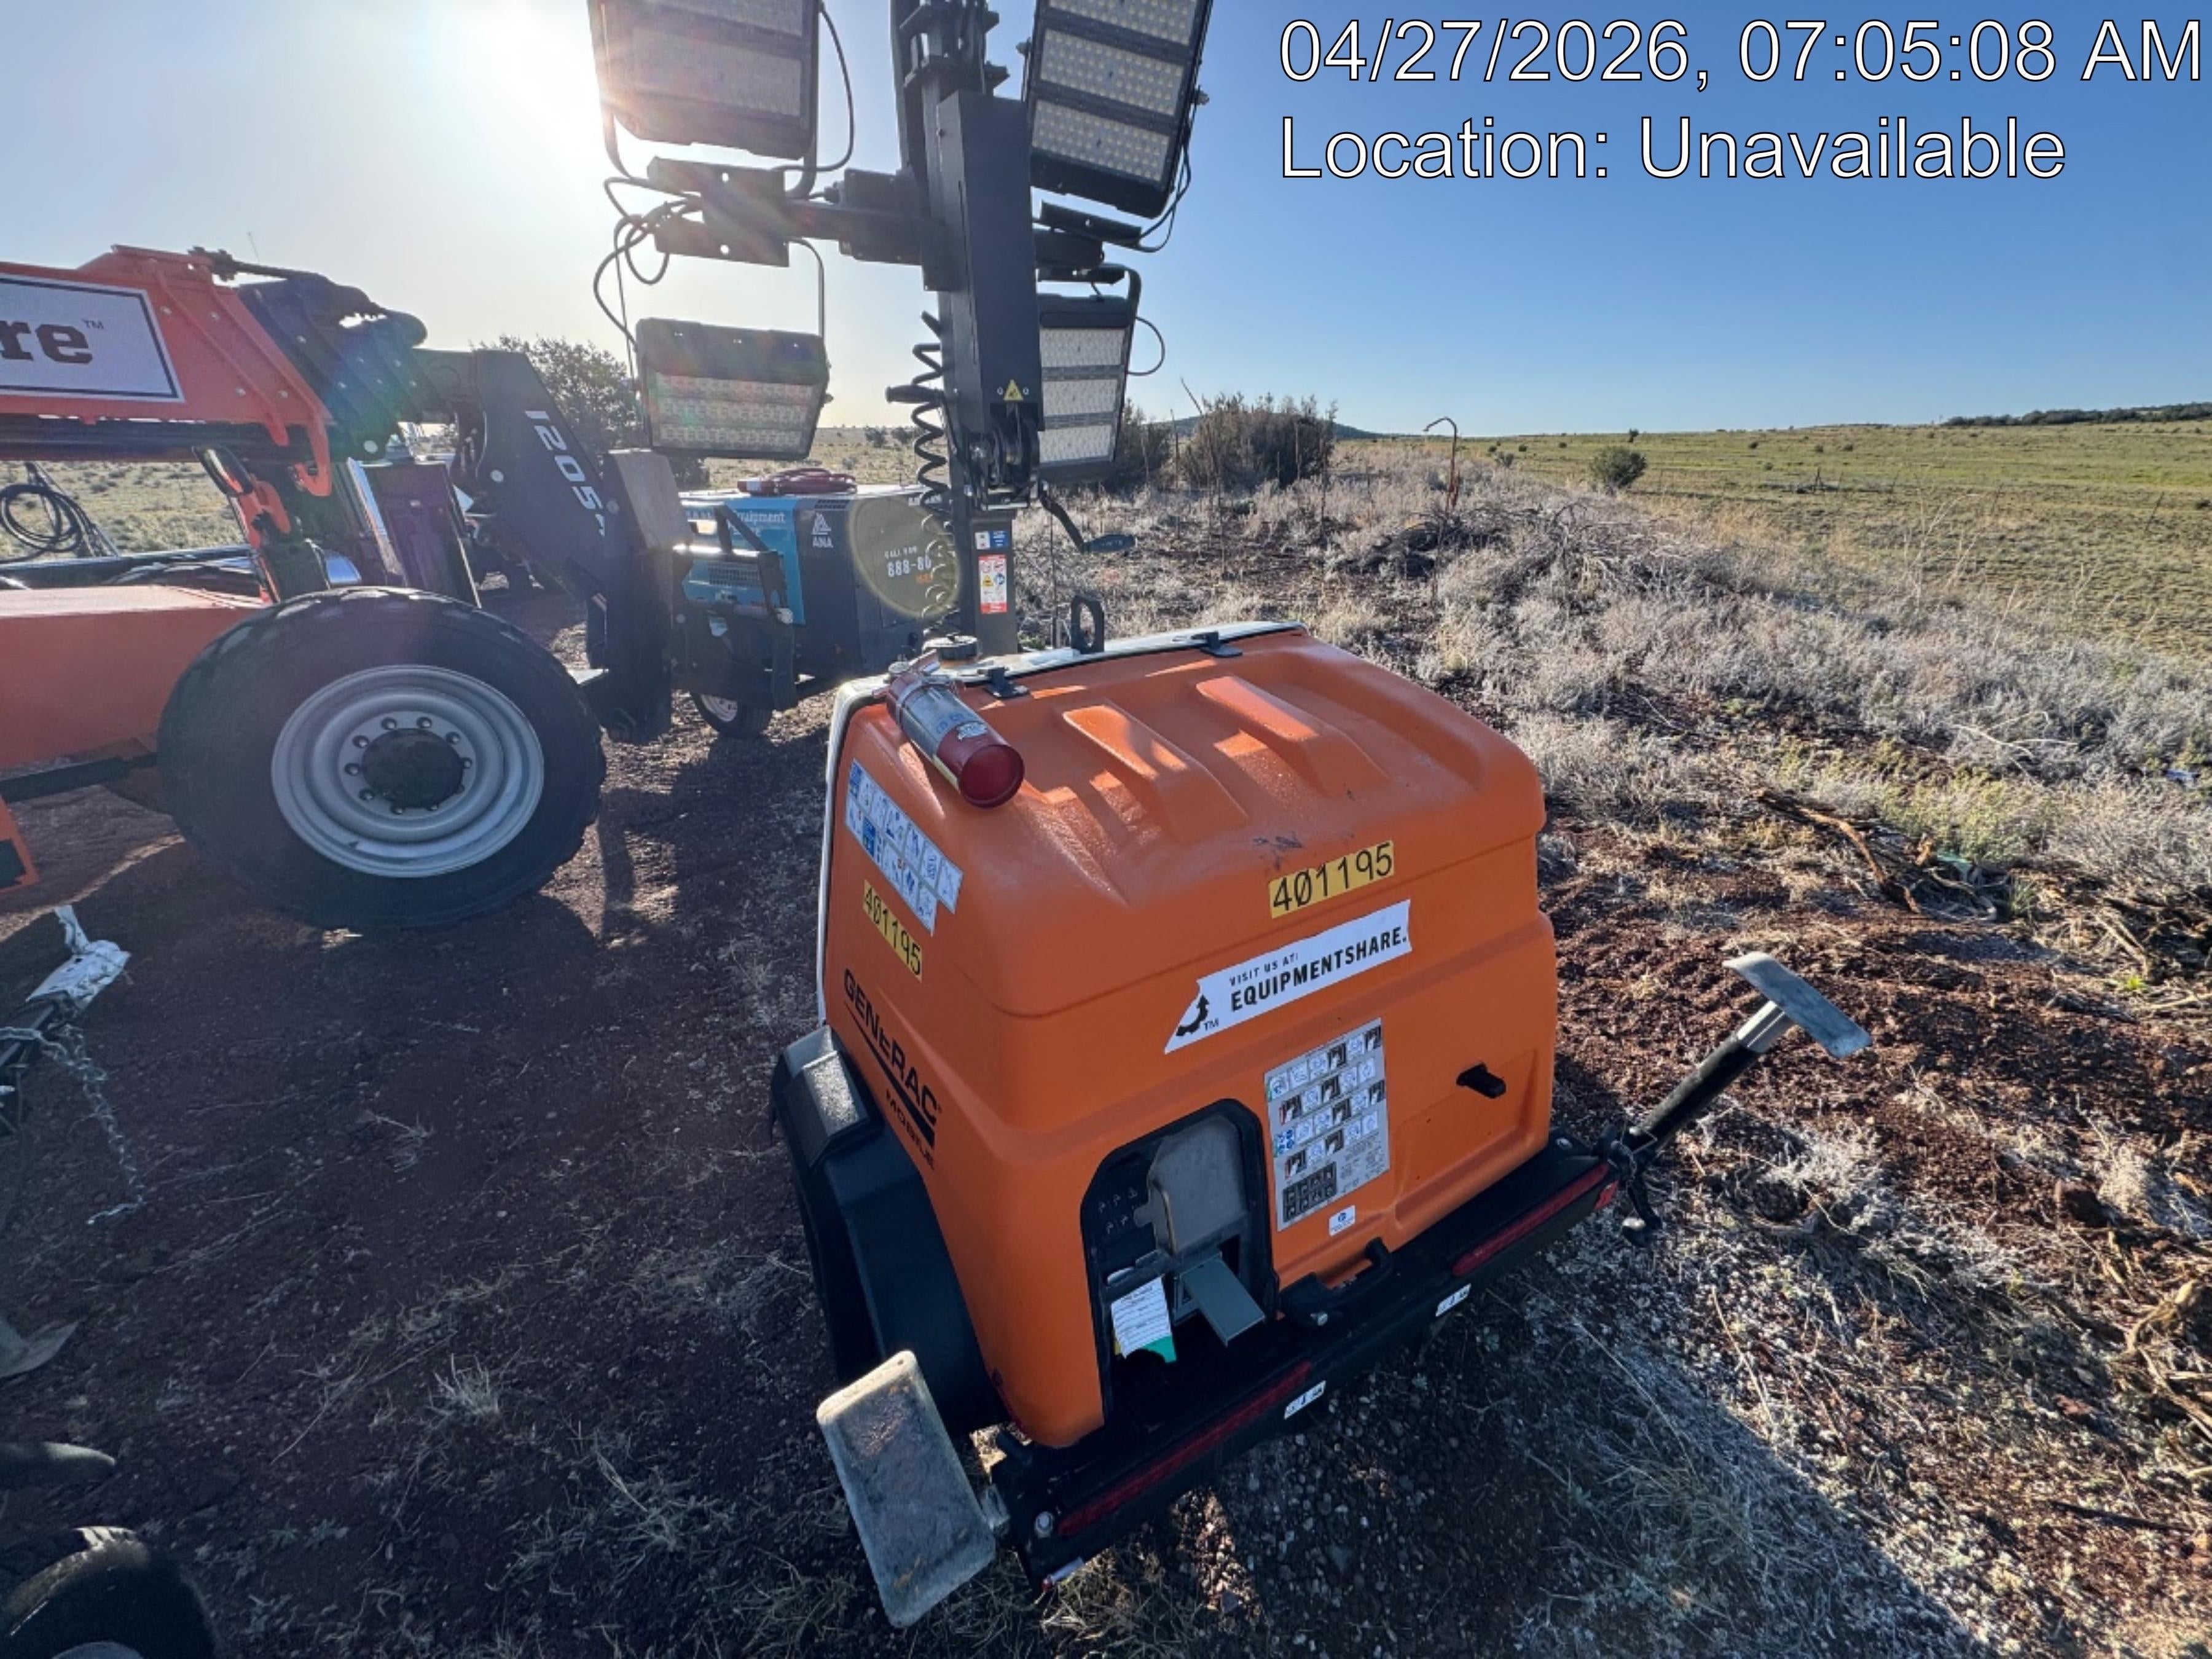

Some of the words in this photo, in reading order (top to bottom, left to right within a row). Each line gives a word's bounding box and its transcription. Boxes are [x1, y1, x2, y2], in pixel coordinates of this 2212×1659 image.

[1273, 842, 1393, 912] 401195
[864, 886, 922, 976] 401195
[1230, 927, 1408, 1013] EQUIPMENTSHARE.
[1229, 967, 1260, 987] VISIT
[1264, 959, 1279, 974] US
